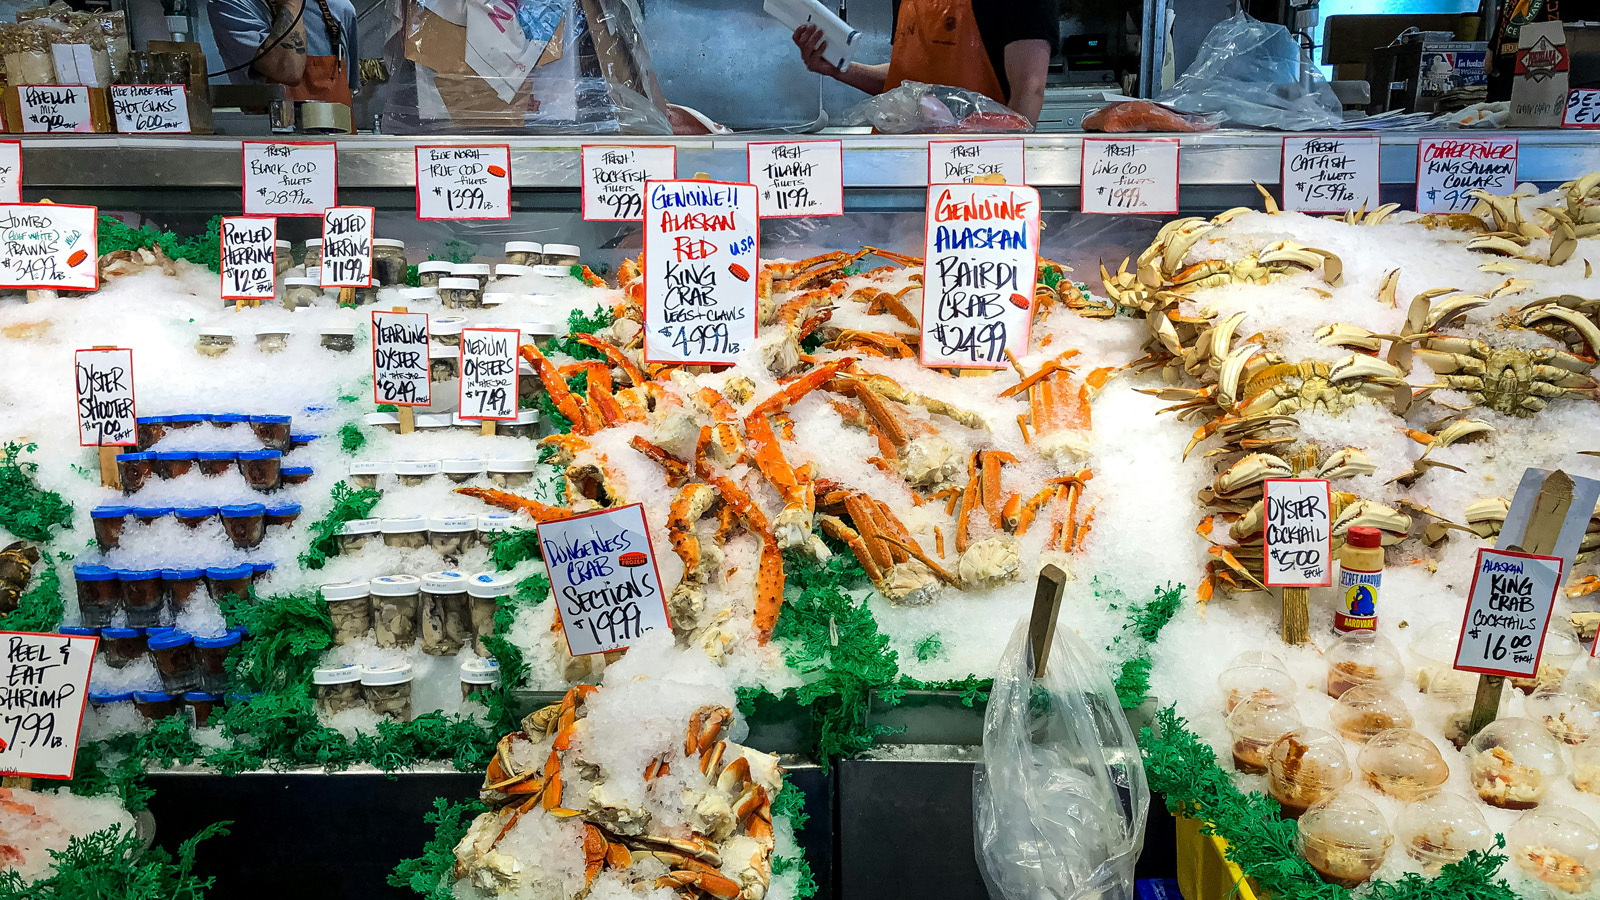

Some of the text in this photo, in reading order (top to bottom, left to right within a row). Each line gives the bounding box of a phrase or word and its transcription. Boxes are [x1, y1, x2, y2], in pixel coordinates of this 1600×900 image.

[26, 86, 78, 107] PAELLA
[113, 99, 176, 115] SHOT GLASS
[40, 105, 58, 114] MIX
[264, 144, 300, 157] FRESH
[950, 145, 983, 158] FRESH
[1103, 143, 1140, 157] FRESH
[1302, 138, 1345, 155] FRESH
[1423, 141, 1517, 163] COPPER RIVER
[251, 159, 317, 175] BLACK COD
[421, 164, 457, 178] TRUE
[459, 163, 483, 176] COD
[762, 162, 819, 179] TILAPIA
[944, 161, 1004, 179] DOVER SOLE
[1092, 160, 1147, 175] LING COD
[1290, 155, 1356, 172] CATFISH
[1427, 160, 1516, 175] KING SALMON
[592, 168, 652, 184] ROCKFISH
[1443, 175, 1505, 189] COLLARS
[651, 184, 740, 210] GENUINE!!
[934, 188, 1033, 223] GENUINE
[0, 210, 52, 228] JUMBO
[326, 211, 366, 235] SALTED
[660, 211, 736, 233] ALASKAN
[222, 223, 272, 246] PICKLED
[934, 220, 1028, 253] ALASKAN
[5, 241, 59, 257] PRAWNS
[221, 246, 274, 267] HERRING
[324, 236, 370, 258] HERRING
[673, 236, 718, 263] RED
[664, 261, 717, 289] KING
[935, 255, 1018, 294] BAIRDI
[664, 286, 718, 310] CRAB
[938, 291, 1006, 322] CRAB
[372, 317, 429, 346] YEARLING
[463, 336, 508, 358] MEDIUM
[375, 347, 428, 371] OYSTER
[76, 361, 127, 402] OYSTER
[379, 372, 388, 380] IN
[464, 357, 514, 384] OYSTERS
[467, 378, 475, 389] IN
[79, 394, 135, 421] SHOOTER
[1266, 496, 1326, 526] OYSTER
[1266, 523, 1328, 546] COCKTAIL
[543, 529, 632, 569] DUNGENESS
[567, 555, 614, 587] CRAB
[1303, 568, 1323, 579] EACH
[1482, 559, 1524, 576] ALASKAN
[1341, 571, 1359, 587] SECRET
[1491, 574, 1534, 597] KING
[563, 567, 655, 616] SECTIONS
[1489, 593, 1535, 613] CRAB
[1344, 616, 1375, 631] AARDVARK
[1473, 608, 1537, 631] COCKTAILS
[8, 637, 52, 664] PEEL
[1513, 653, 1535, 664] EACH
[6, 664, 61, 687] EAT
[0, 684, 75, 711] SHRIMP
[0, 712, 55, 751] 7.99
